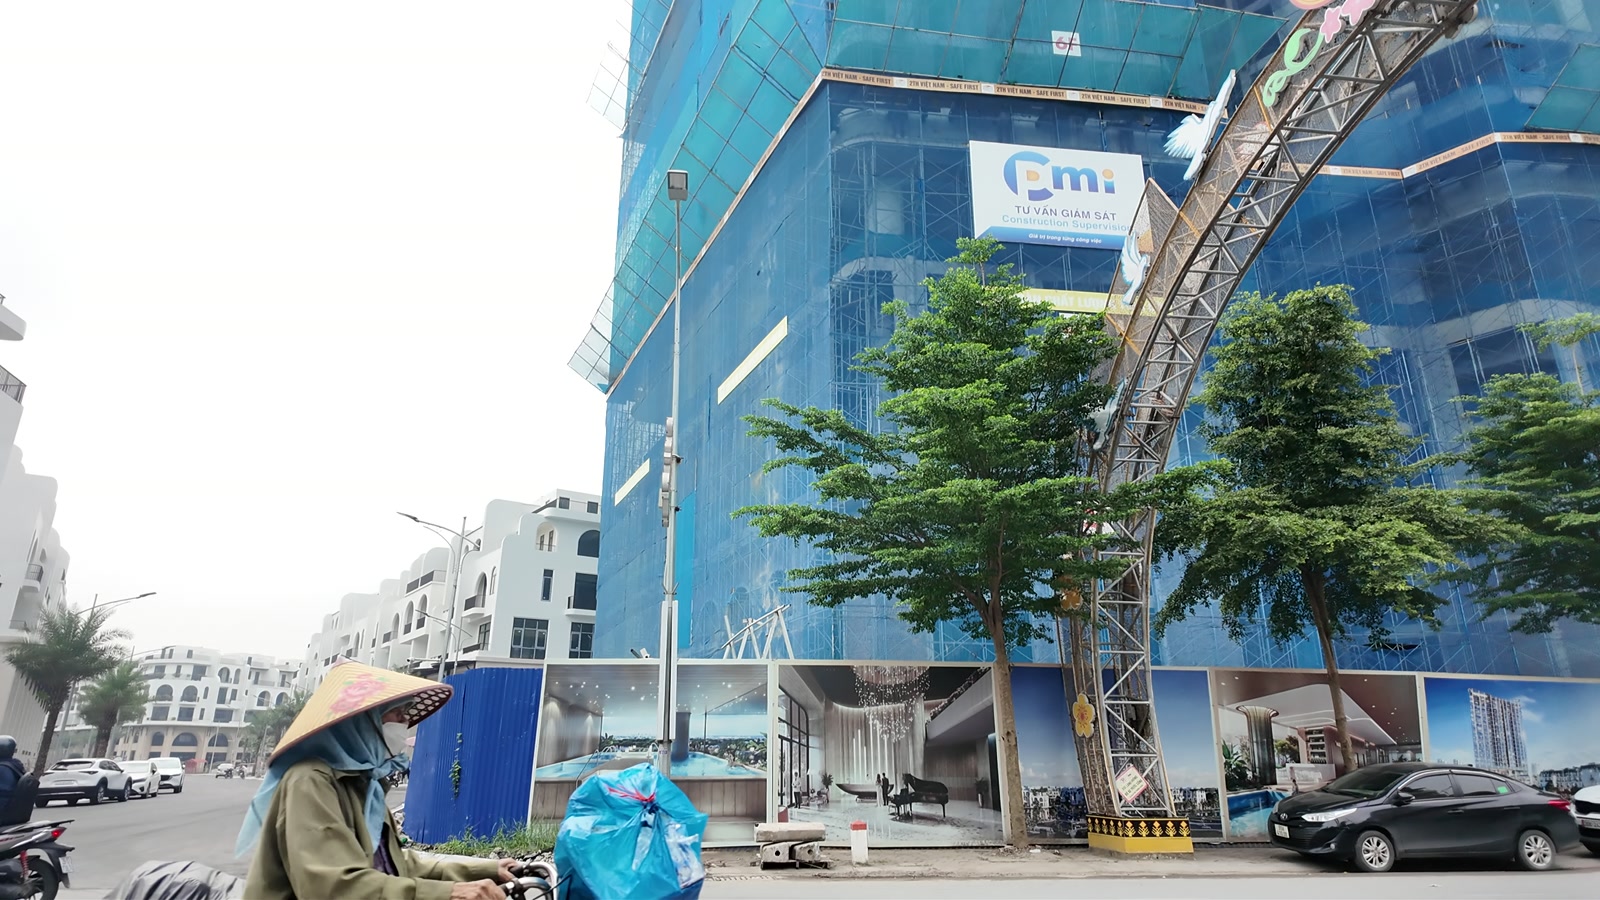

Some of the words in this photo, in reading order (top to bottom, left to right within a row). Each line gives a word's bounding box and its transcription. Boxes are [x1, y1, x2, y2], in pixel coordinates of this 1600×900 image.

[876, 77, 891, 85] FIRST
[1036, 89, 1049, 97] SAFE
[1014, 204, 1031, 215] TƯ
[1033, 204, 1058, 217] VẤN
[1061, 208, 1091, 220] GIÁM
[1094, 211, 1117, 221] SÁT
[1002, 214, 1069, 228] Construction
[1046, 234, 1062, 242] trong
[1075, 236, 1090, 244] công
